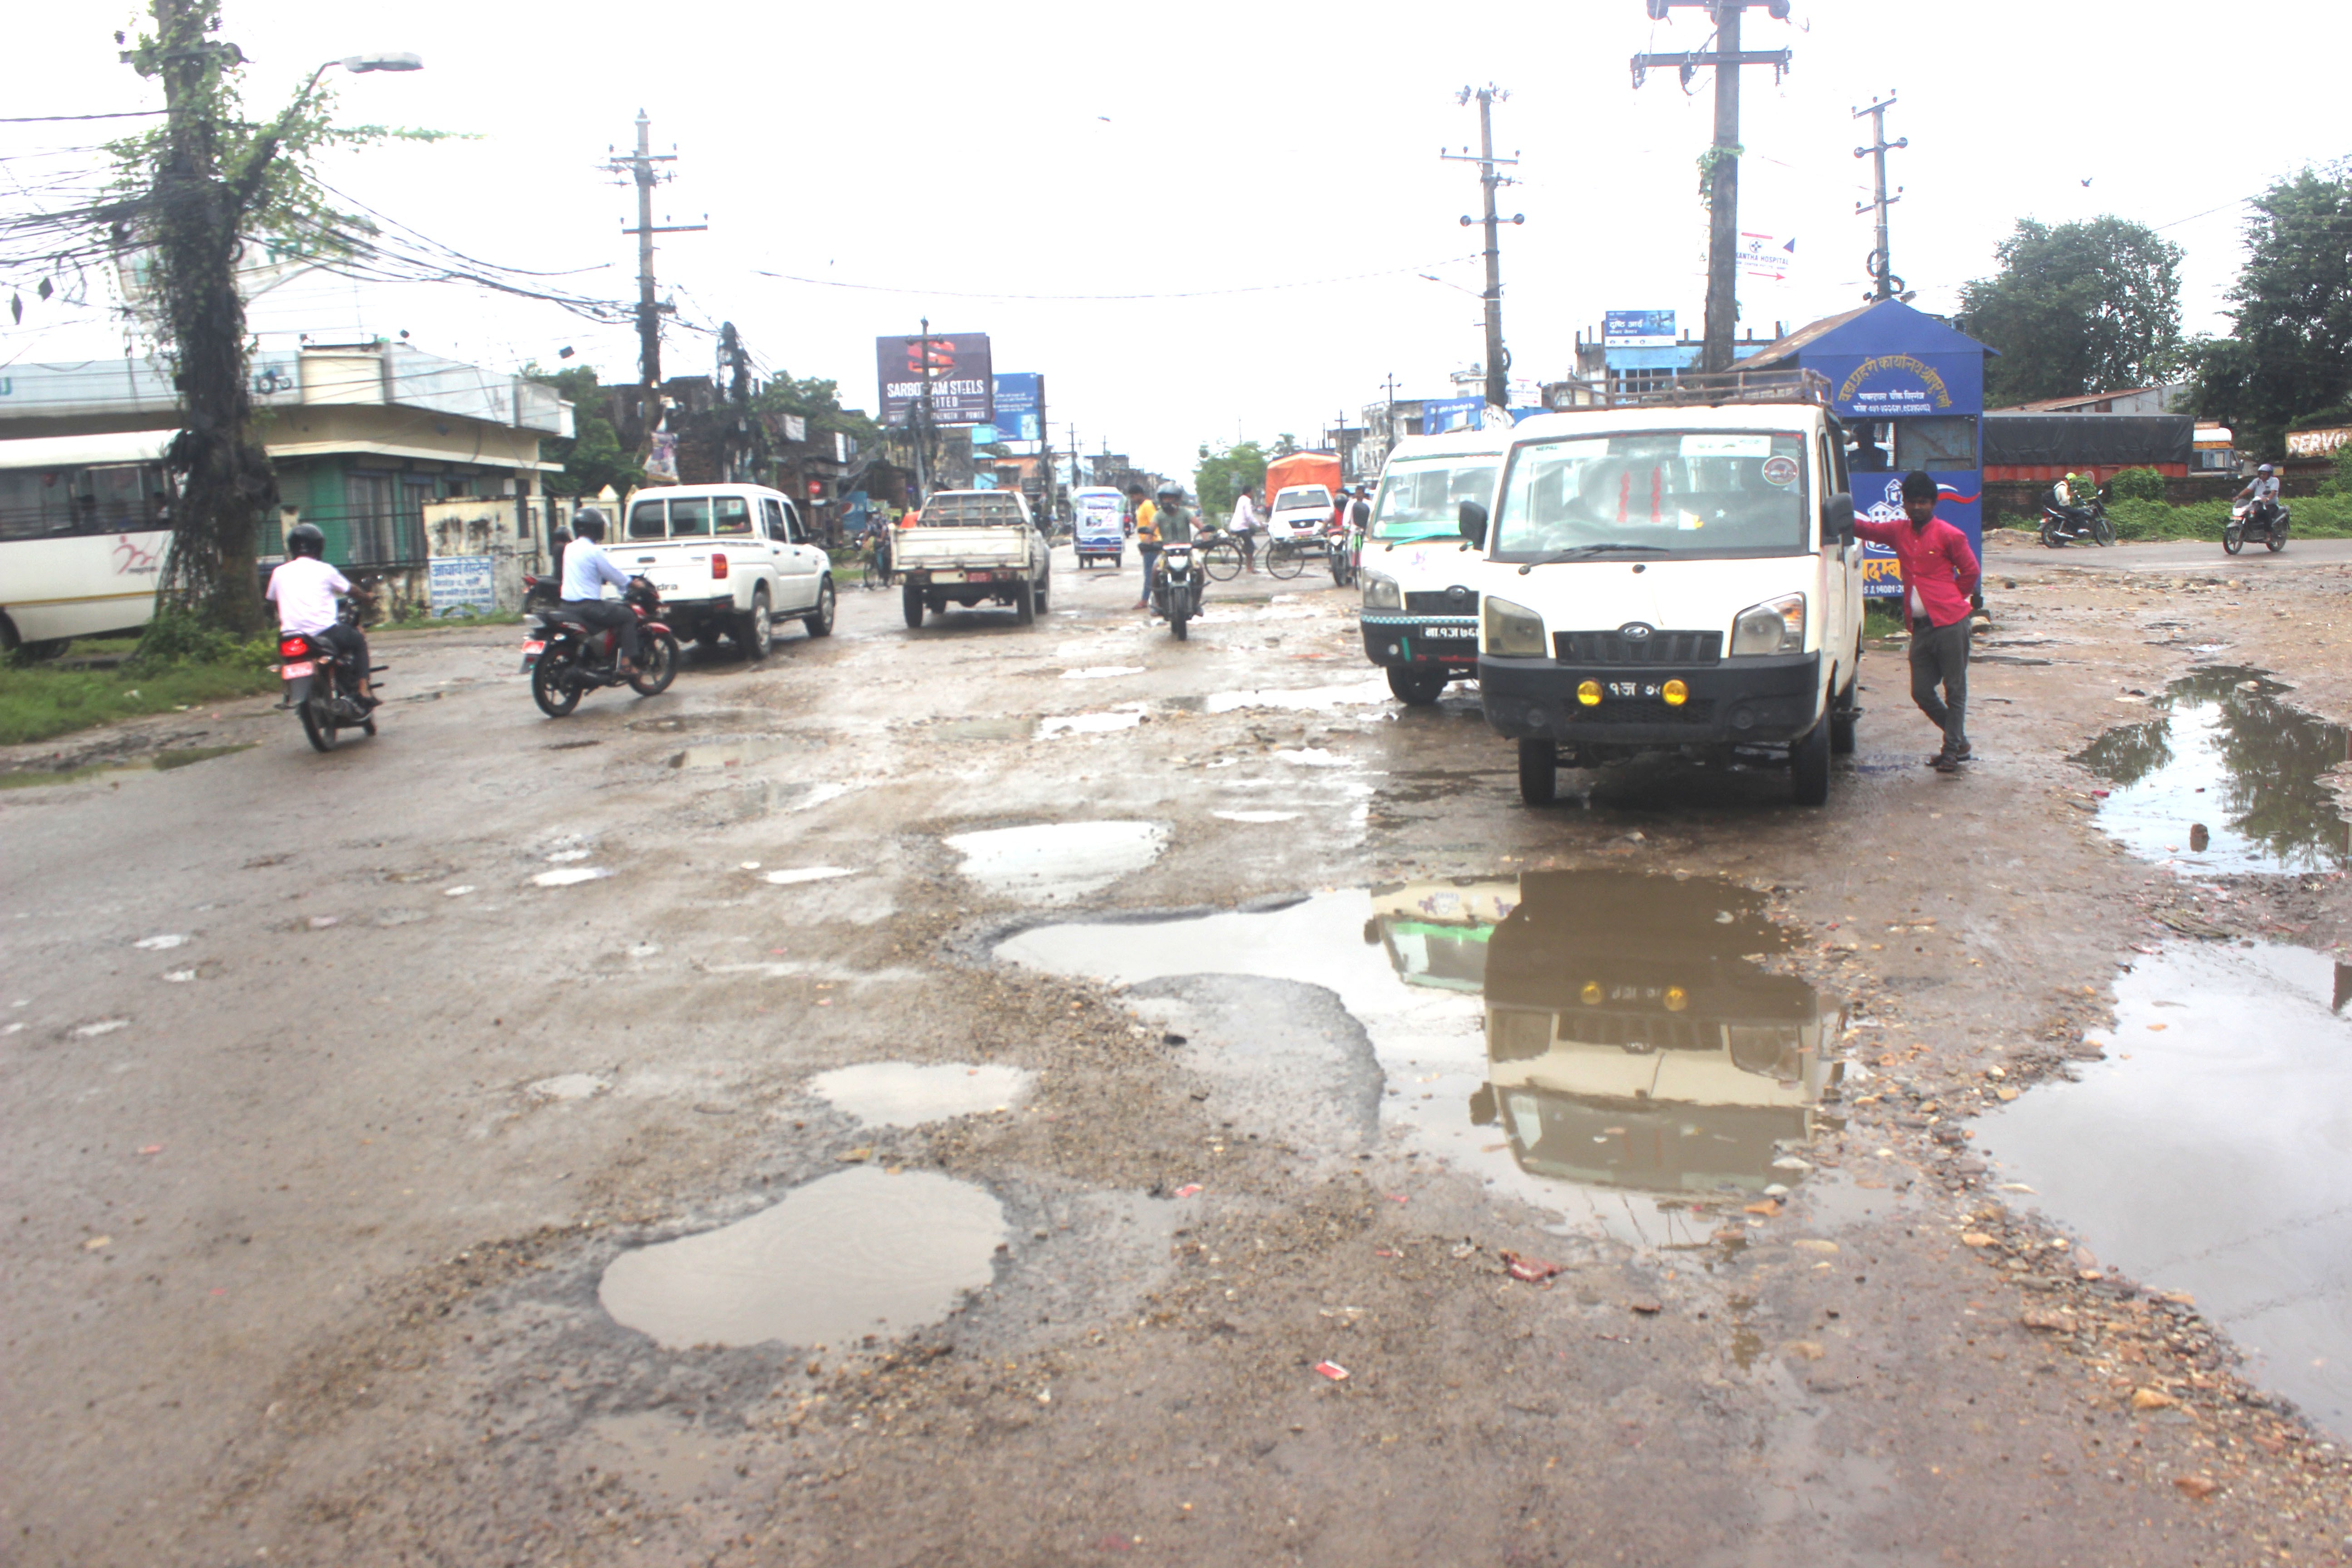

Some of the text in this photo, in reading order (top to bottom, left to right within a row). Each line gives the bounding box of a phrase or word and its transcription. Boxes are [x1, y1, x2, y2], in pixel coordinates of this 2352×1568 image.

[1761, 255, 1788, 265] HOSPITAL
[887, 379, 984, 398] SARBOAM STEELS
[2288, 432, 2348, 453] SERVO
